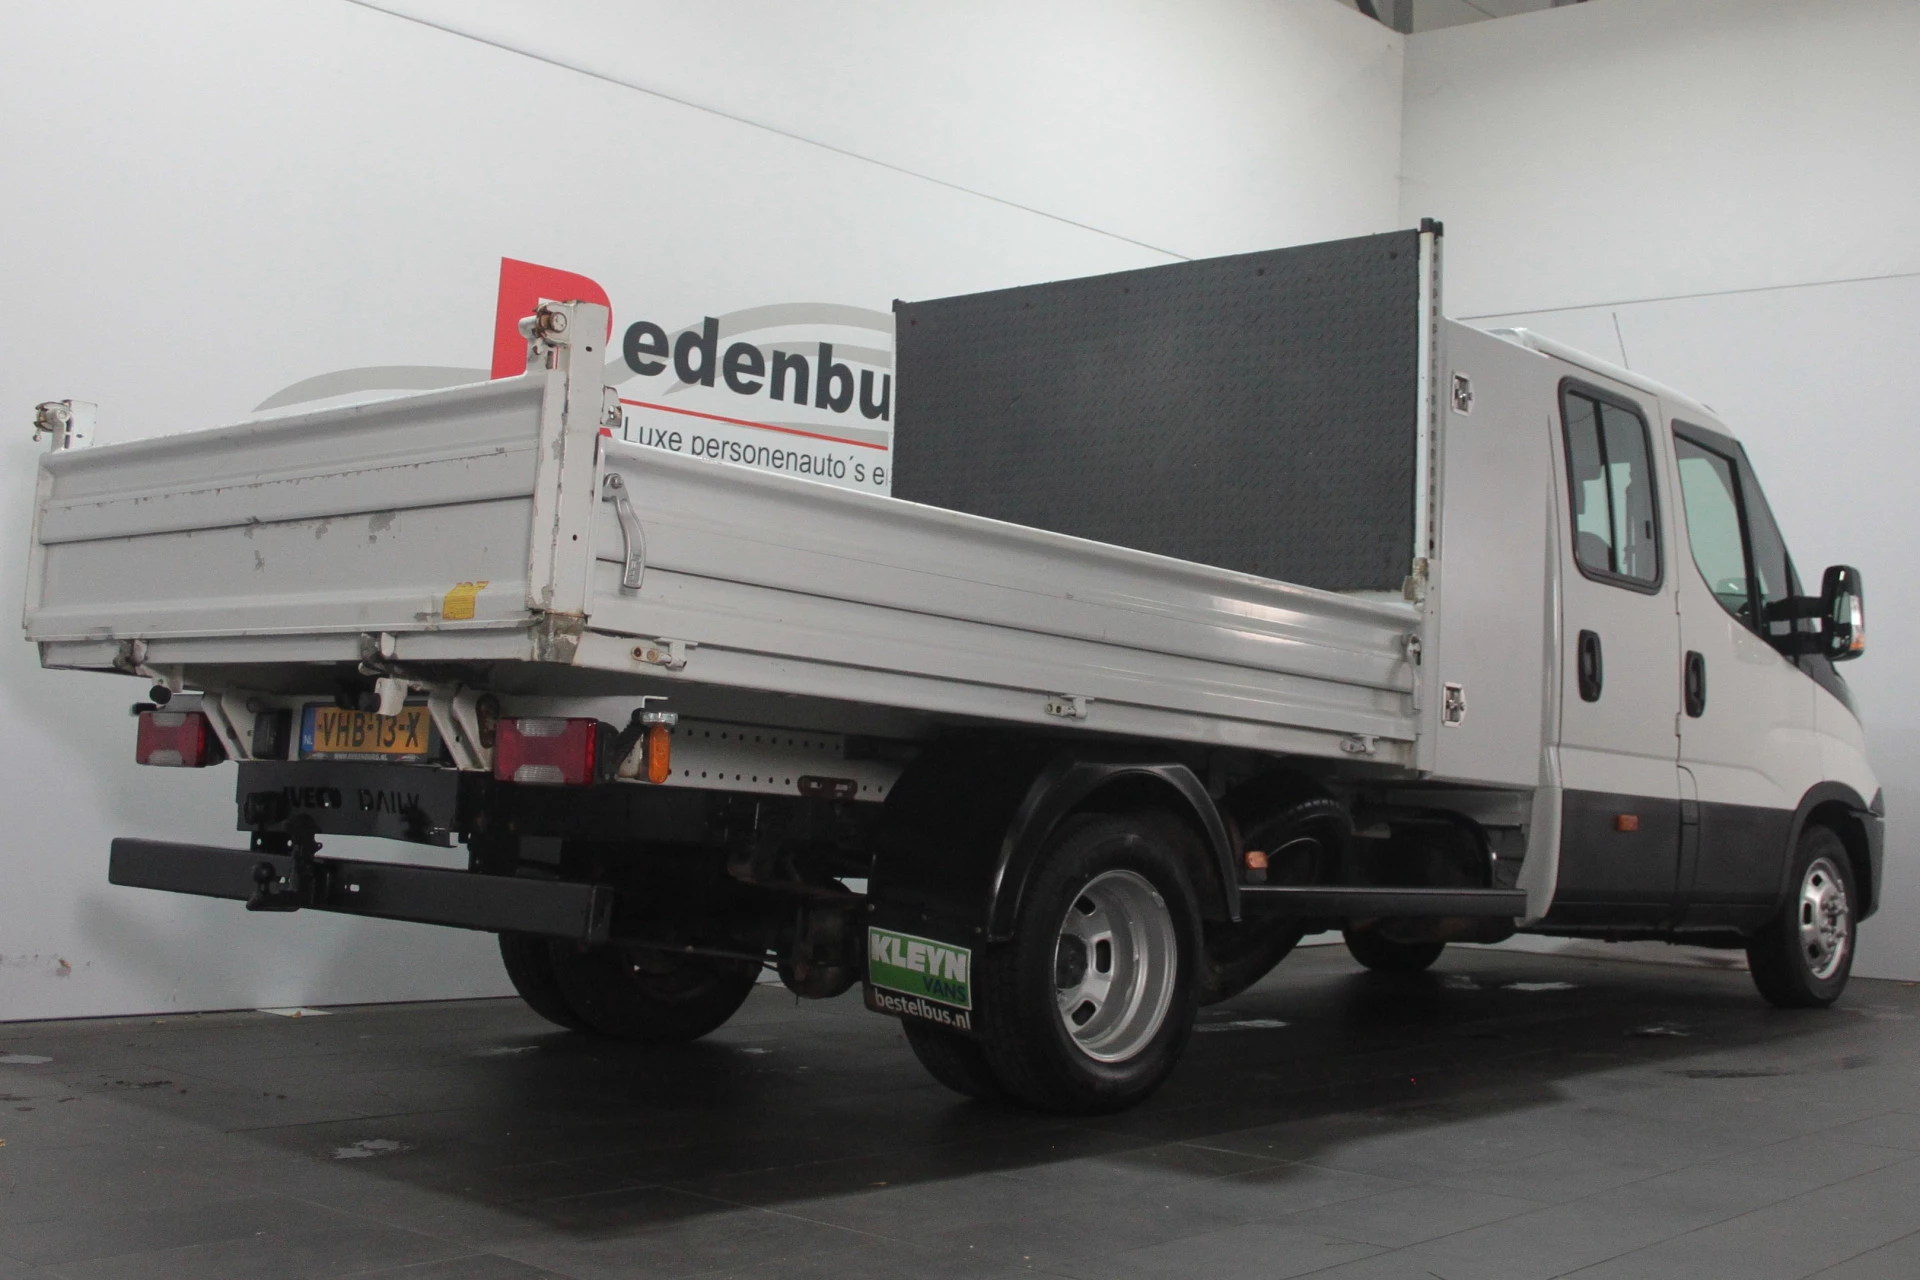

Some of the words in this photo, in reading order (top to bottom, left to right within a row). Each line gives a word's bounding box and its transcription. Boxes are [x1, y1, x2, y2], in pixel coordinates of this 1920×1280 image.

[623, 416, 683, 452] Luxe
[322, 711, 421, 748] VHB-13-X
[358, 788, 420, 815] DAILY
[871, 933, 967, 984] KLEYN
[923, 975, 968, 1003] VANS
[874, 987, 971, 1030] bestelbus.nl
